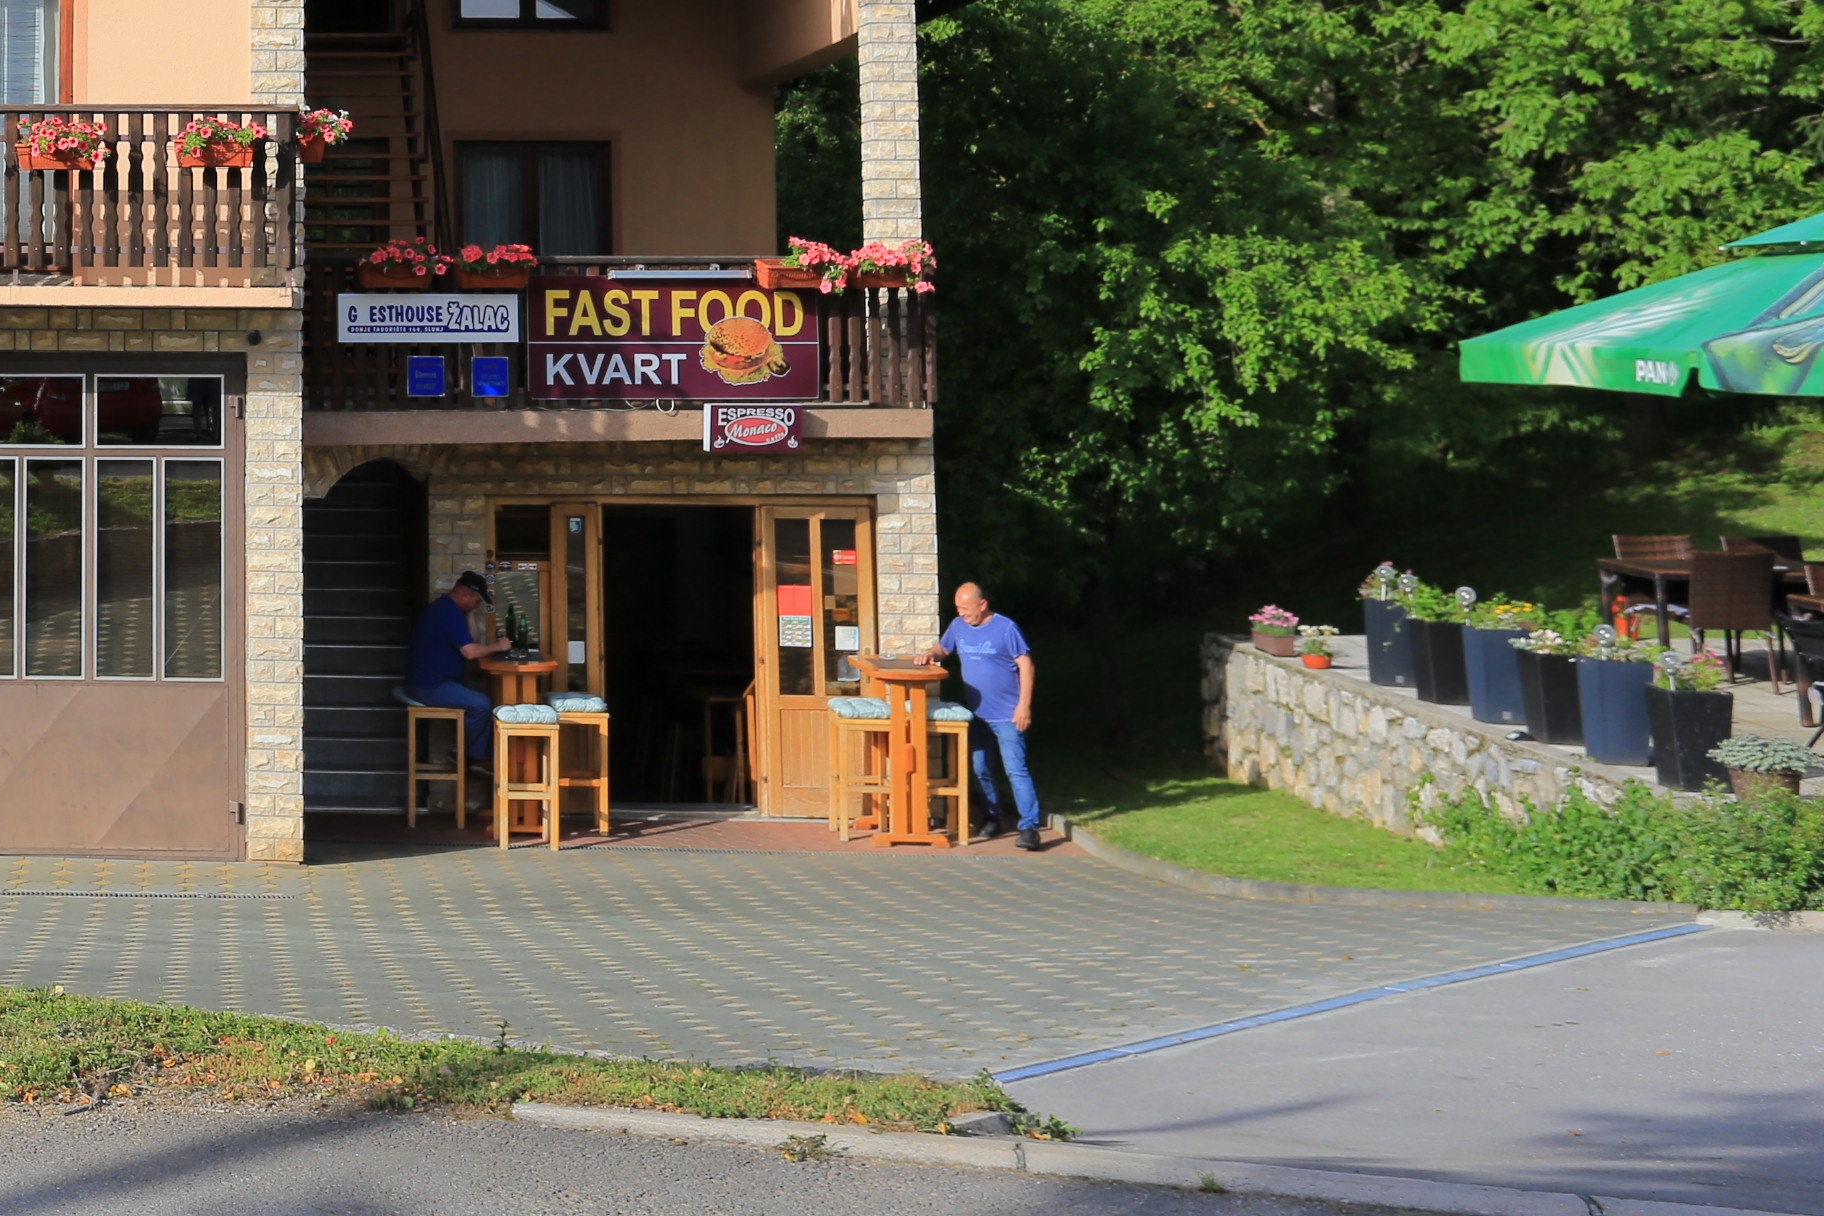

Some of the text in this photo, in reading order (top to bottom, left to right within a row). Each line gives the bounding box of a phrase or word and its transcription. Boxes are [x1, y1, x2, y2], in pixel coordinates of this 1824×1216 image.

[447, 301, 510, 332] ŽALAC
[545, 289, 804, 336] FAST FOOD
[546, 353, 687, 386] KVART
[717, 407, 795, 426] ESPRESSO
[726, 422, 778, 444] Monaco
